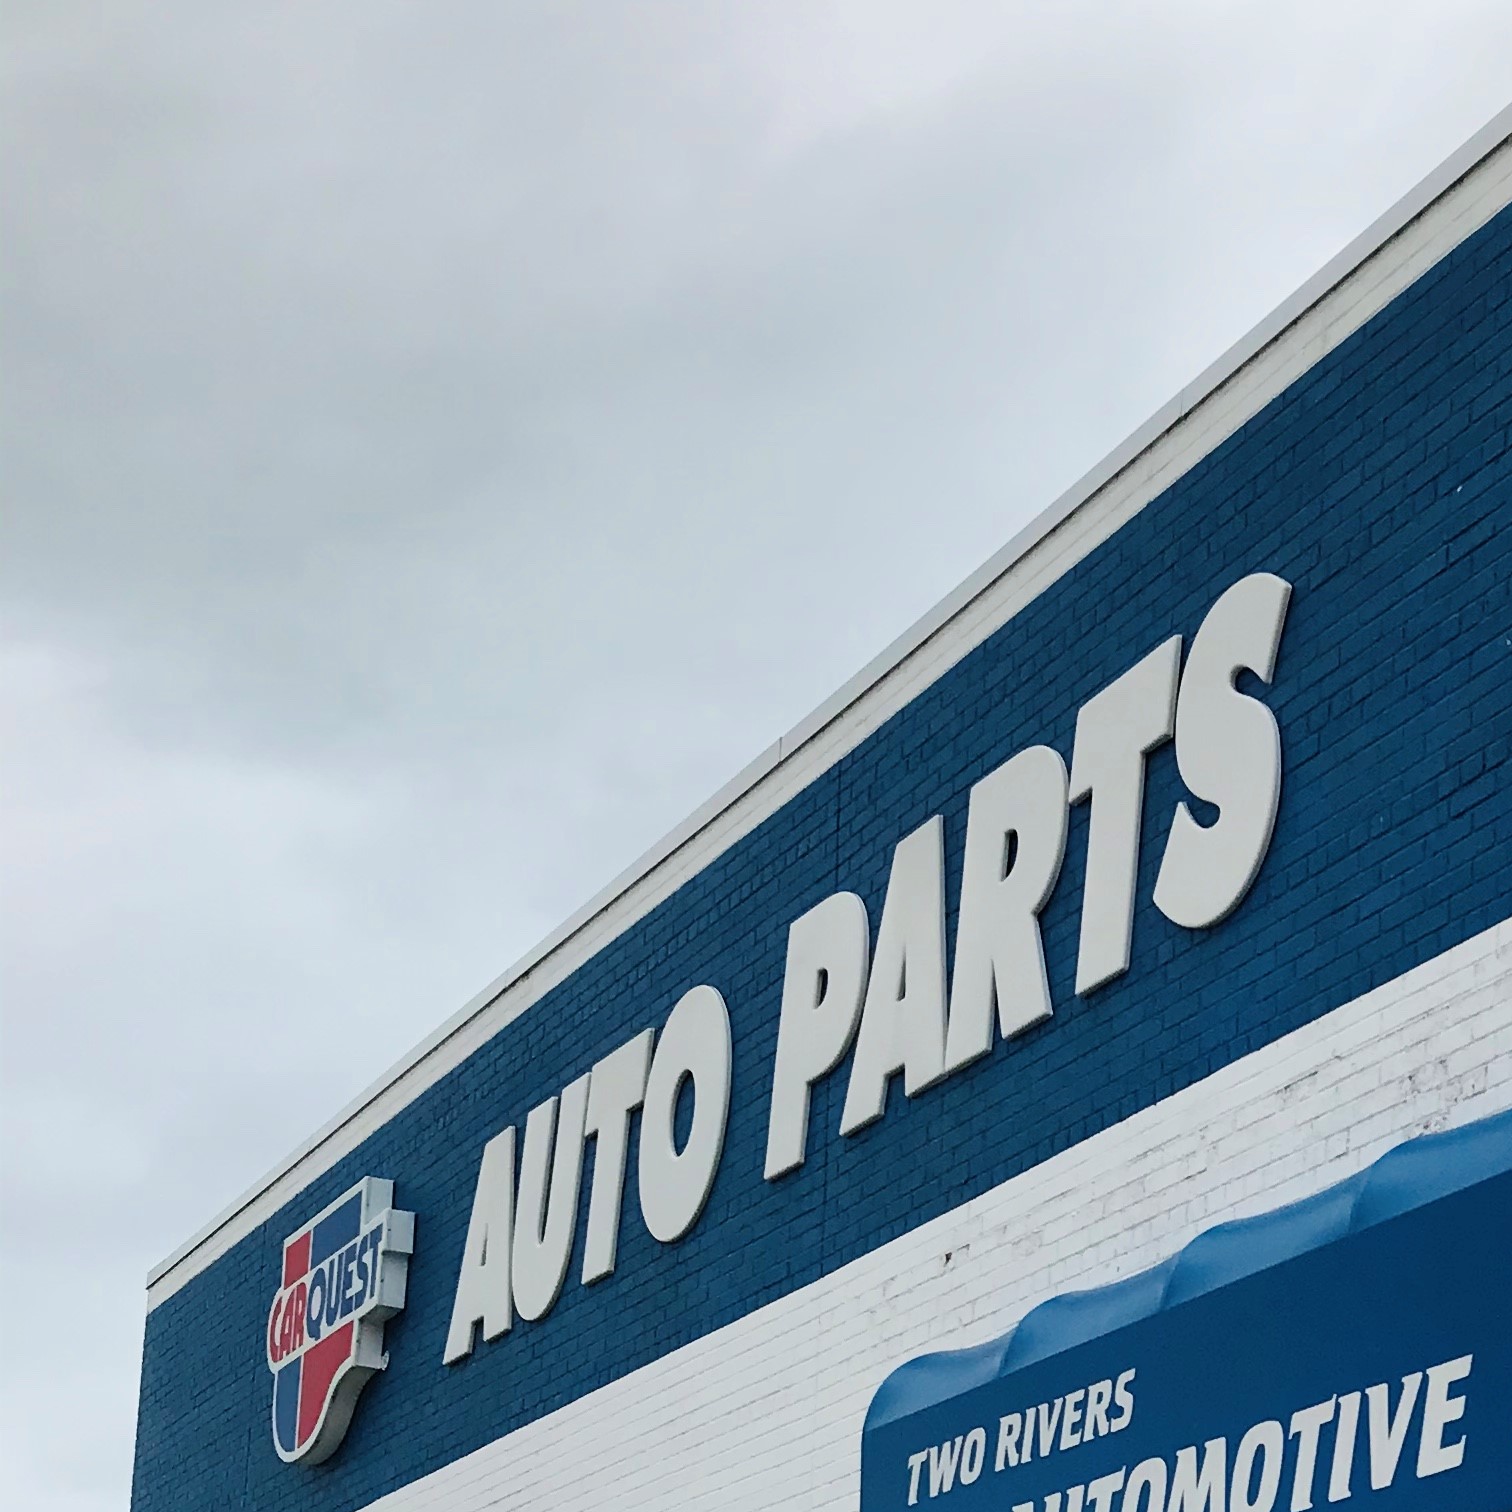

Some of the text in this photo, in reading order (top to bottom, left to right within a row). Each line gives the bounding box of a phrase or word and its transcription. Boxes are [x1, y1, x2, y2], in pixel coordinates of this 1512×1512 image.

[443, 572, 1293, 1367] AUTO PARTS
[269, 1226, 384, 1364] CARQUEST
[907, 1368, 1137, 1506] TWO RIVERS
